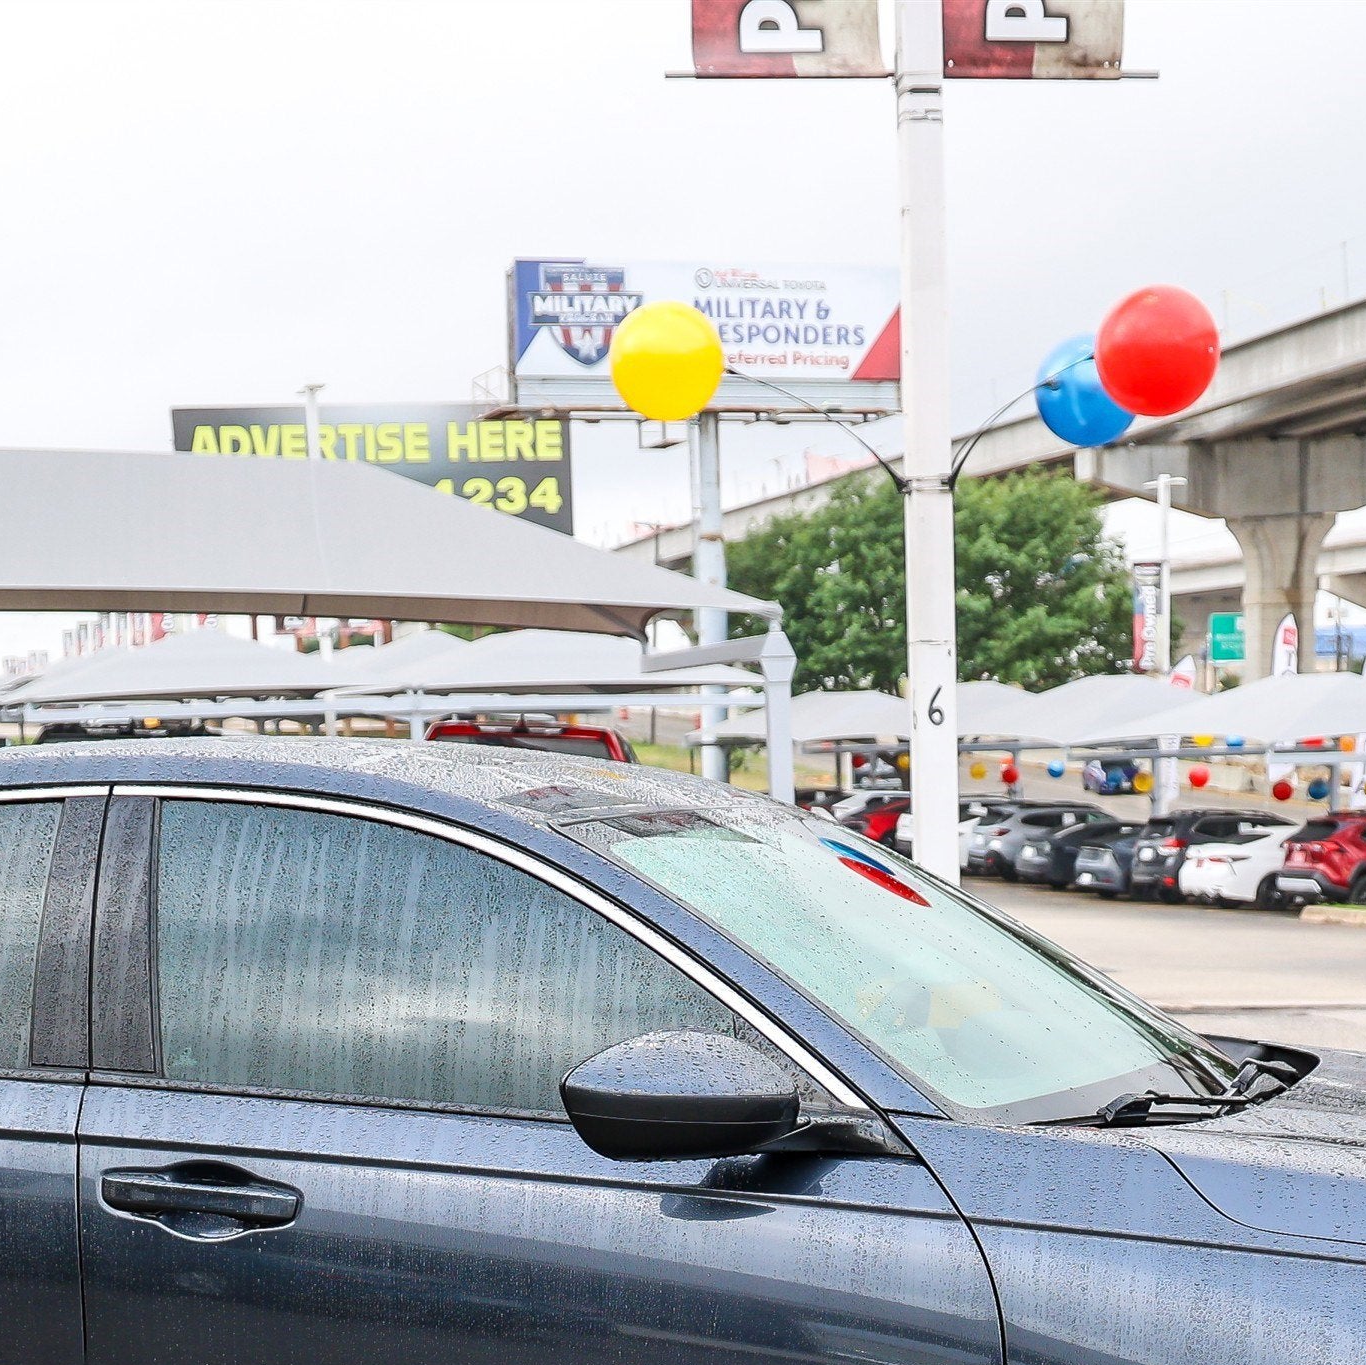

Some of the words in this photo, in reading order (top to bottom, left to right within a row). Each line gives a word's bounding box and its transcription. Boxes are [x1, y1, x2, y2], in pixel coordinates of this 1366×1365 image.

[532, 294, 641, 316] MILITARY
[694, 297, 808, 319] MILITARY
[718, 323, 865, 346] ESPONDERS
[724, 350, 787, 365] eferred
[792, 351, 850, 370] Pricing
[190, 421, 431, 464] ADVERTISE
[446, 419, 564, 463] HERE
[928, 685, 945, 726] 6
